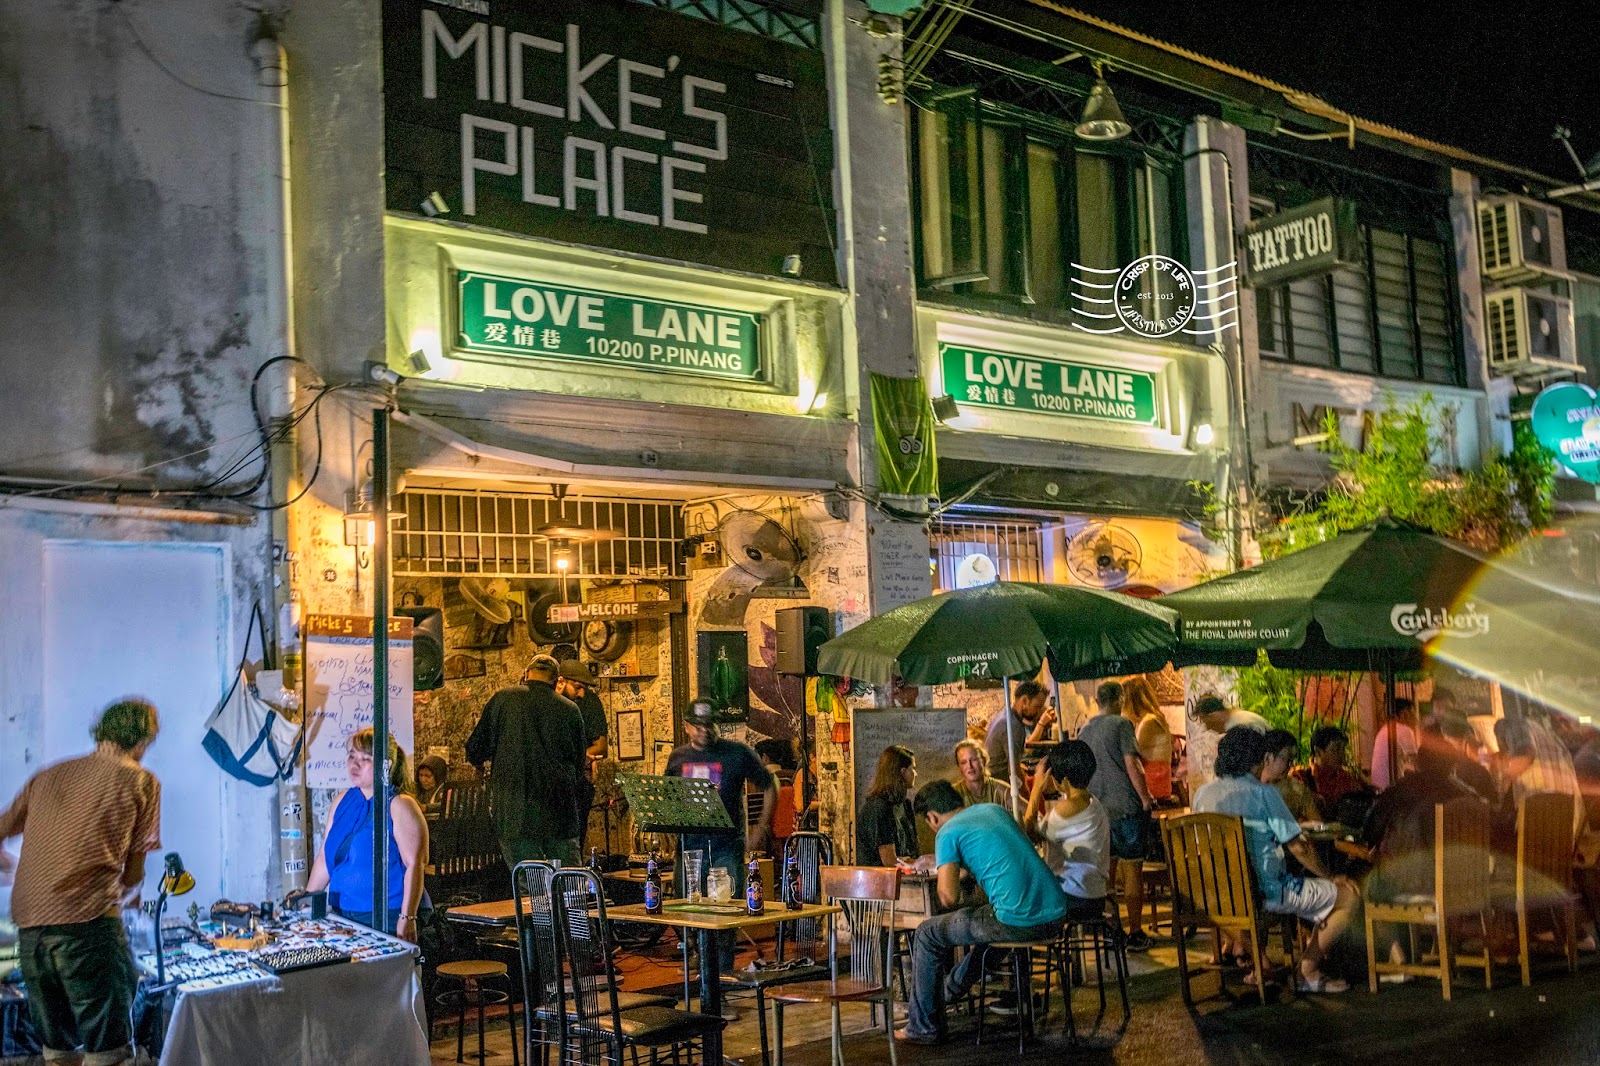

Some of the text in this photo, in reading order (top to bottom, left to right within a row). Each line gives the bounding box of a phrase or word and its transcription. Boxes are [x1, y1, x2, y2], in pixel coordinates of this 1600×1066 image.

[421, 9, 729, 160] MICKE'S
[460, 113, 708, 235] PLACE
[1247, 212, 1333, 272] TATTOO
[483, 282, 742, 349] LOVE LANE
[484, 322, 561, 350] 愛情巷
[586, 336, 743, 371] 10200 P.PINANG
[964, 352, 1135, 402] LOVE LANE
[1031, 392, 1137, 419] 10200 P.PINANG
[578, 603, 639, 616] WELCOME
[1185, 619, 1252, 629] BY APPOINTMENT TO
[1390, 602, 1490, 643] Carlsberg
[1184, 628, 1291, 640] THE ROYAL DANISH COURT
[946, 652, 999, 664] COPENHAGEN
[958, 661, 989, 677] 1847
